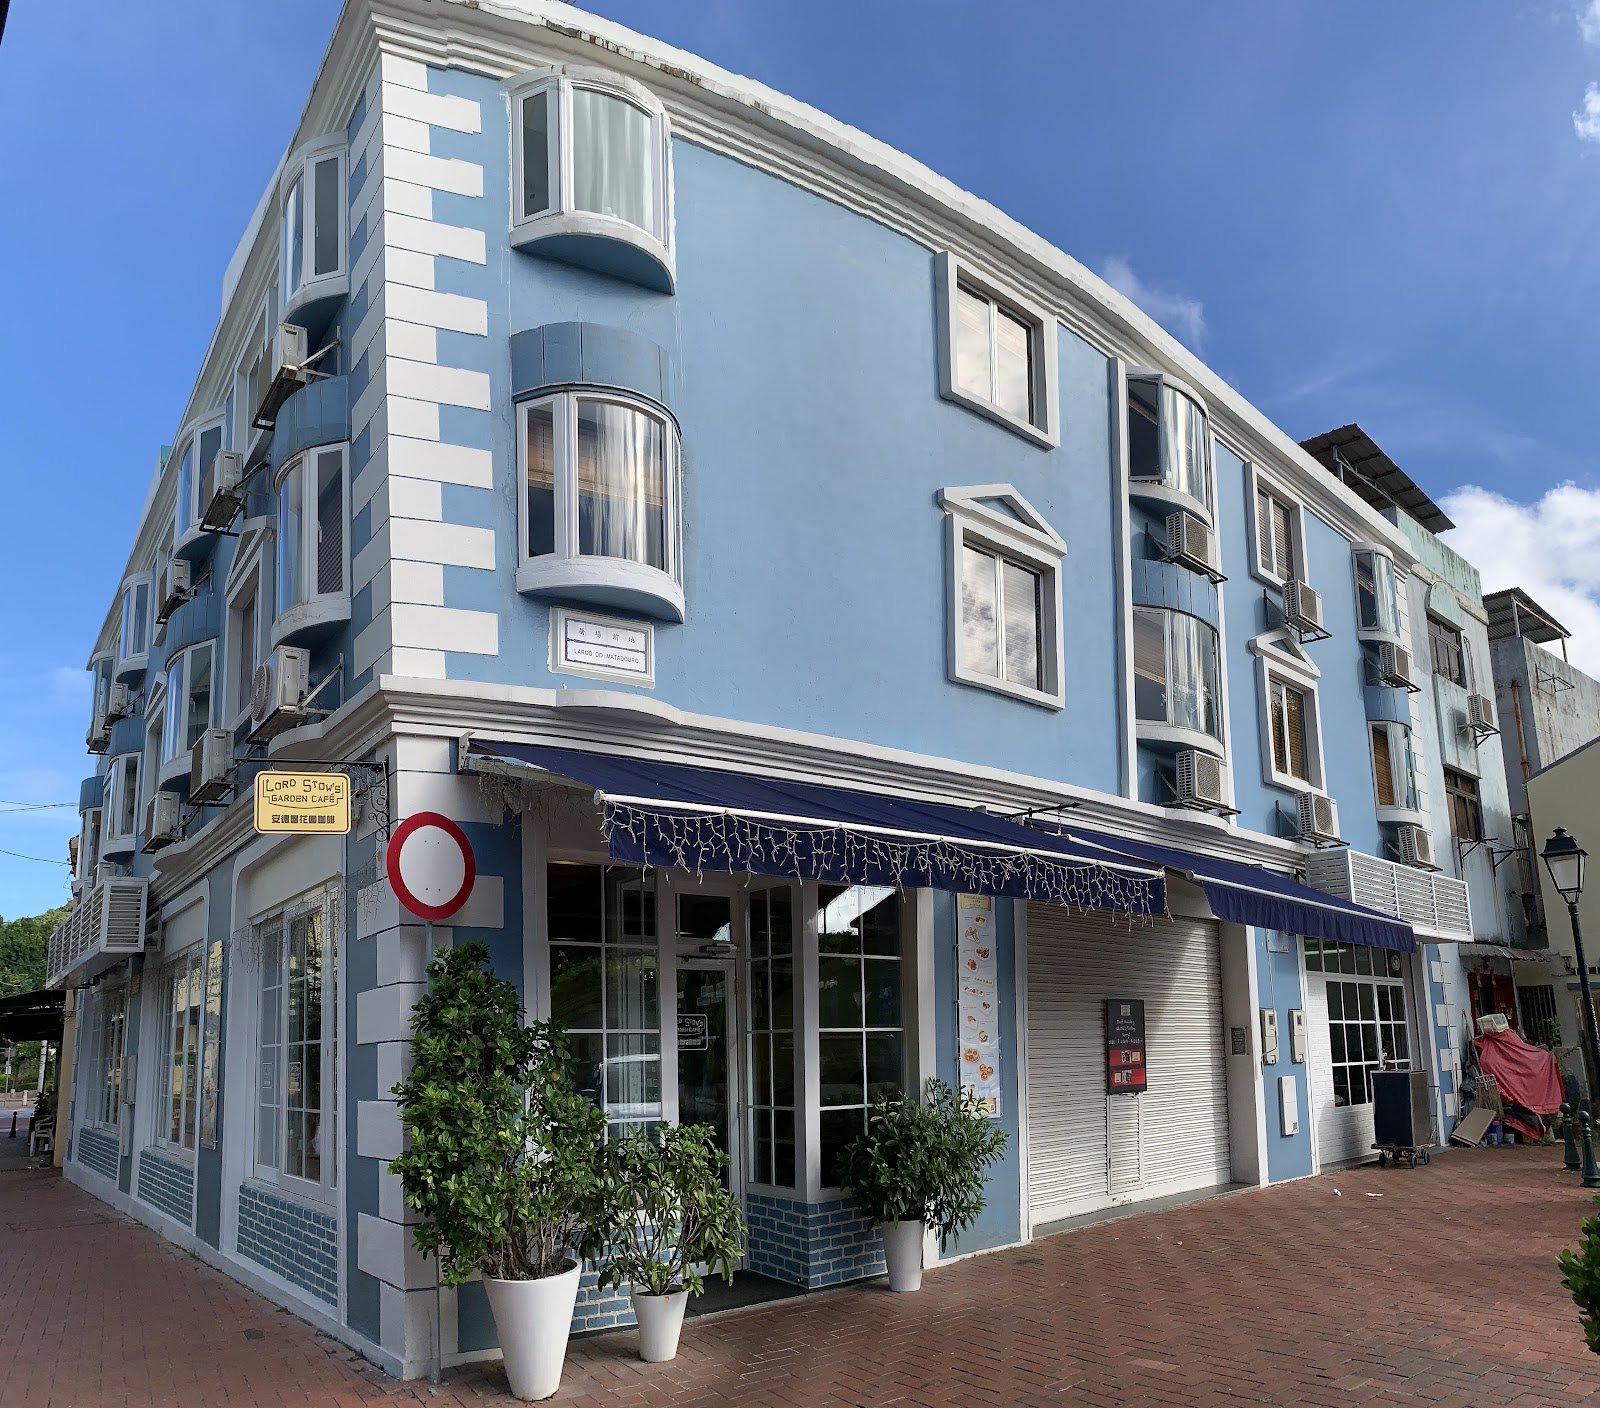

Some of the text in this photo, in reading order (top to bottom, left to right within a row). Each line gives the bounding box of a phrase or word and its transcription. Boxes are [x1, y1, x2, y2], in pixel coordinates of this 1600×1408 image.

[574, 648, 593, 657] LARGO
[606, 653, 639, 664] MATADOURO
[265, 778, 297, 792] LORD
[271, 793, 335, 803] GARDEN CAFÉ
